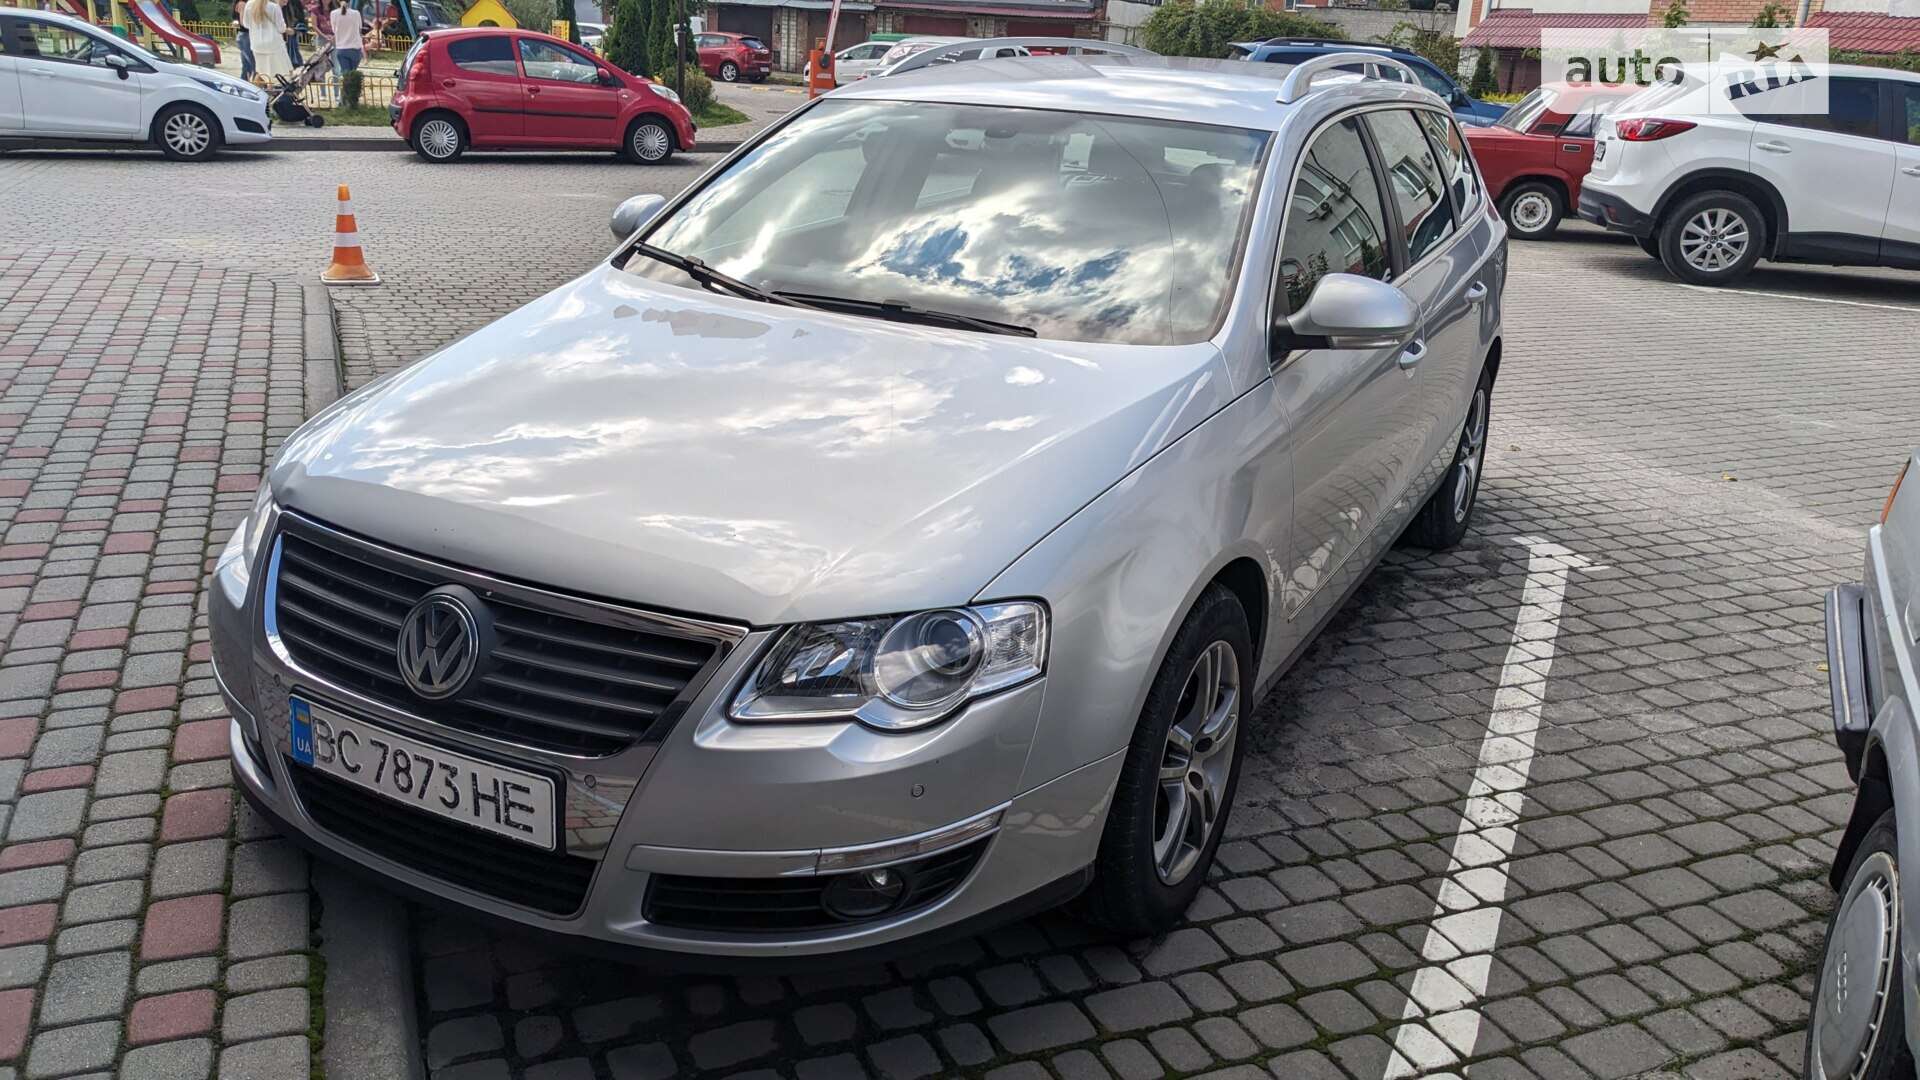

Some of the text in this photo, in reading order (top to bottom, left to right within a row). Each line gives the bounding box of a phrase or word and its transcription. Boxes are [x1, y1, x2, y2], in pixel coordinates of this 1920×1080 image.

[297, 738, 312, 754] UA
[312, 716, 535, 833] BC 7873 HE
